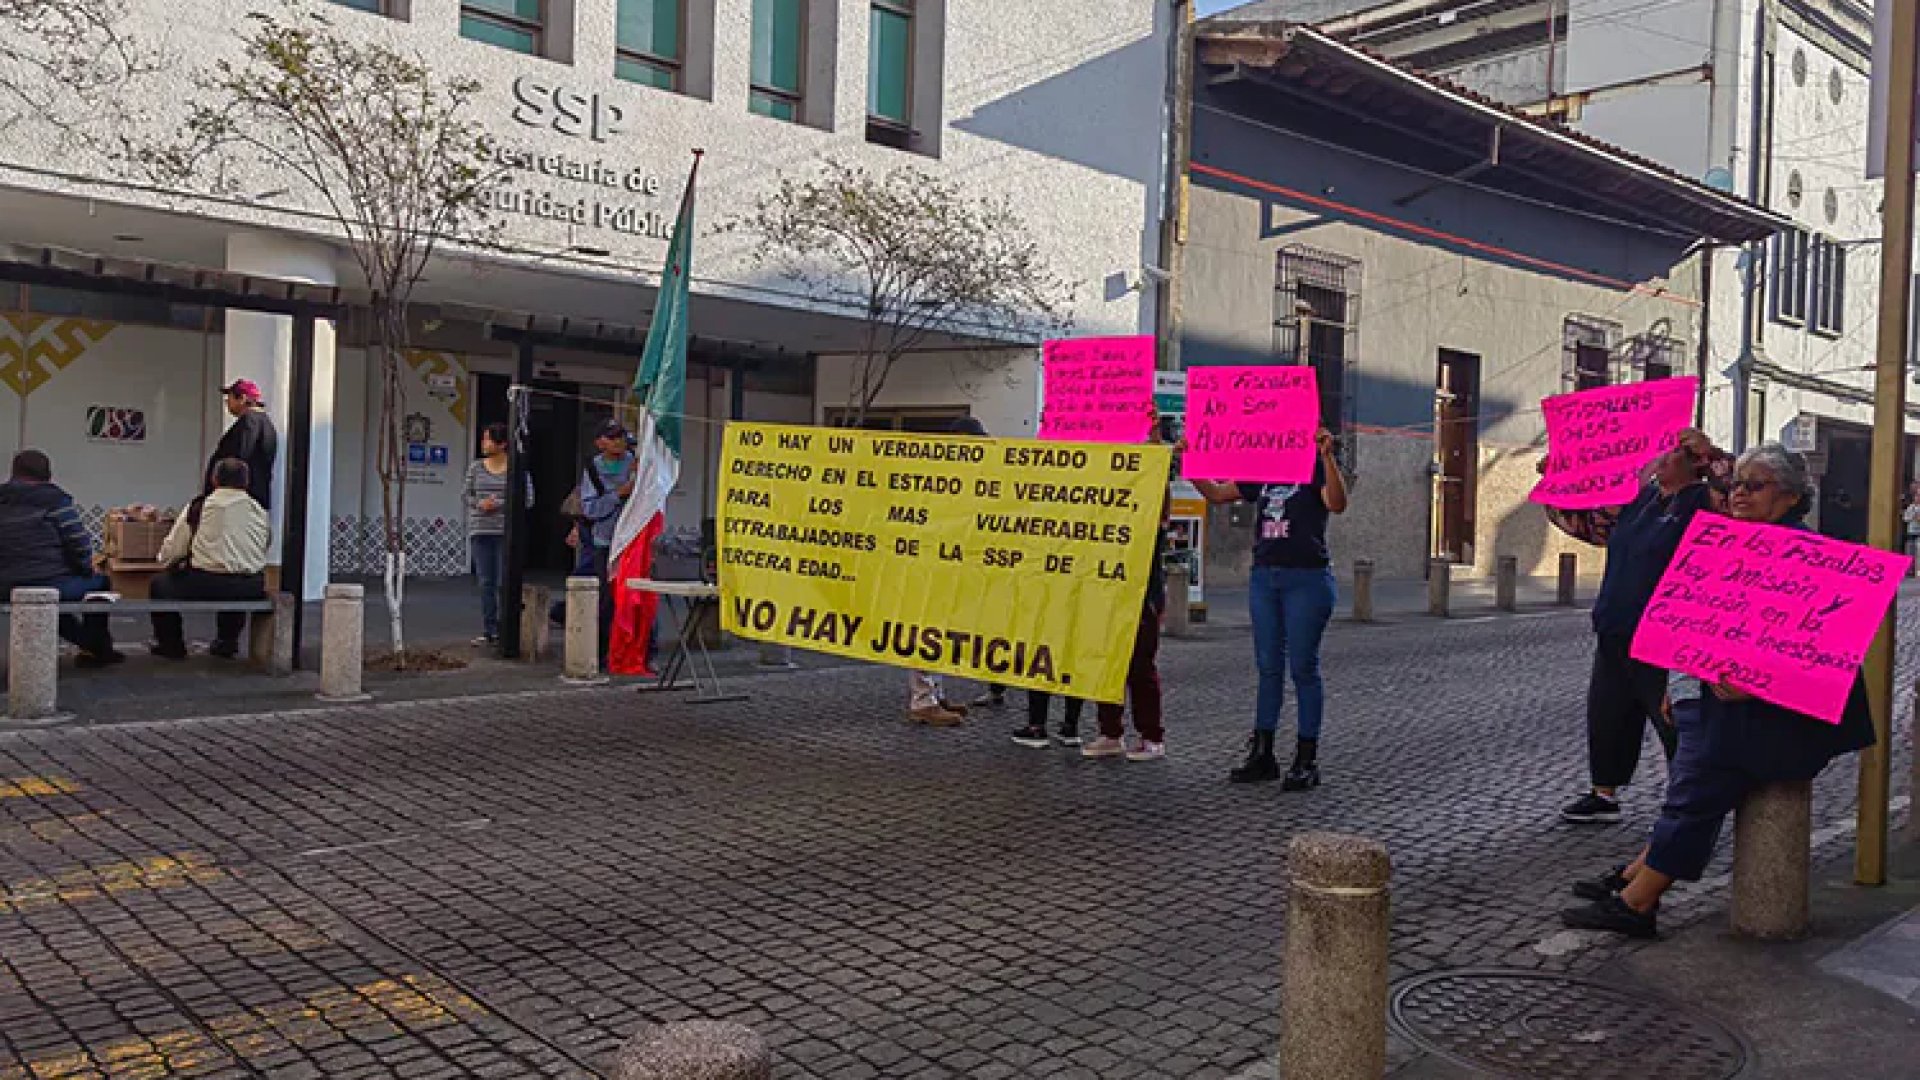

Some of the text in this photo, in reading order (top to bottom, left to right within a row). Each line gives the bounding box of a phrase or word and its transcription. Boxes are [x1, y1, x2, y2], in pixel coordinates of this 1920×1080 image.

[512, 76, 628, 143] SSP
[624, 165, 661, 196] de
[593, 200, 677, 241] Públic
[739, 430, 1142, 472] NO HAY UN VERDADERO ESTADO DE
[731, 458, 1140, 512] DERECHO EN EL ESTADO DE VERACRUZ,
[726, 488, 1132, 545] PARA LOS MAS VULNERABLES
[1692, 523, 1738, 547] En
[724, 517, 1127, 581] EXTRABAJADORES DE LA SSP DE LA
[796, 558, 856, 582] EDAD...
[1724, 621, 1752, 642] de
[1760, 606, 1788, 628] en
[734, 595, 1072, 685] NO HAY JUSTICIA.
